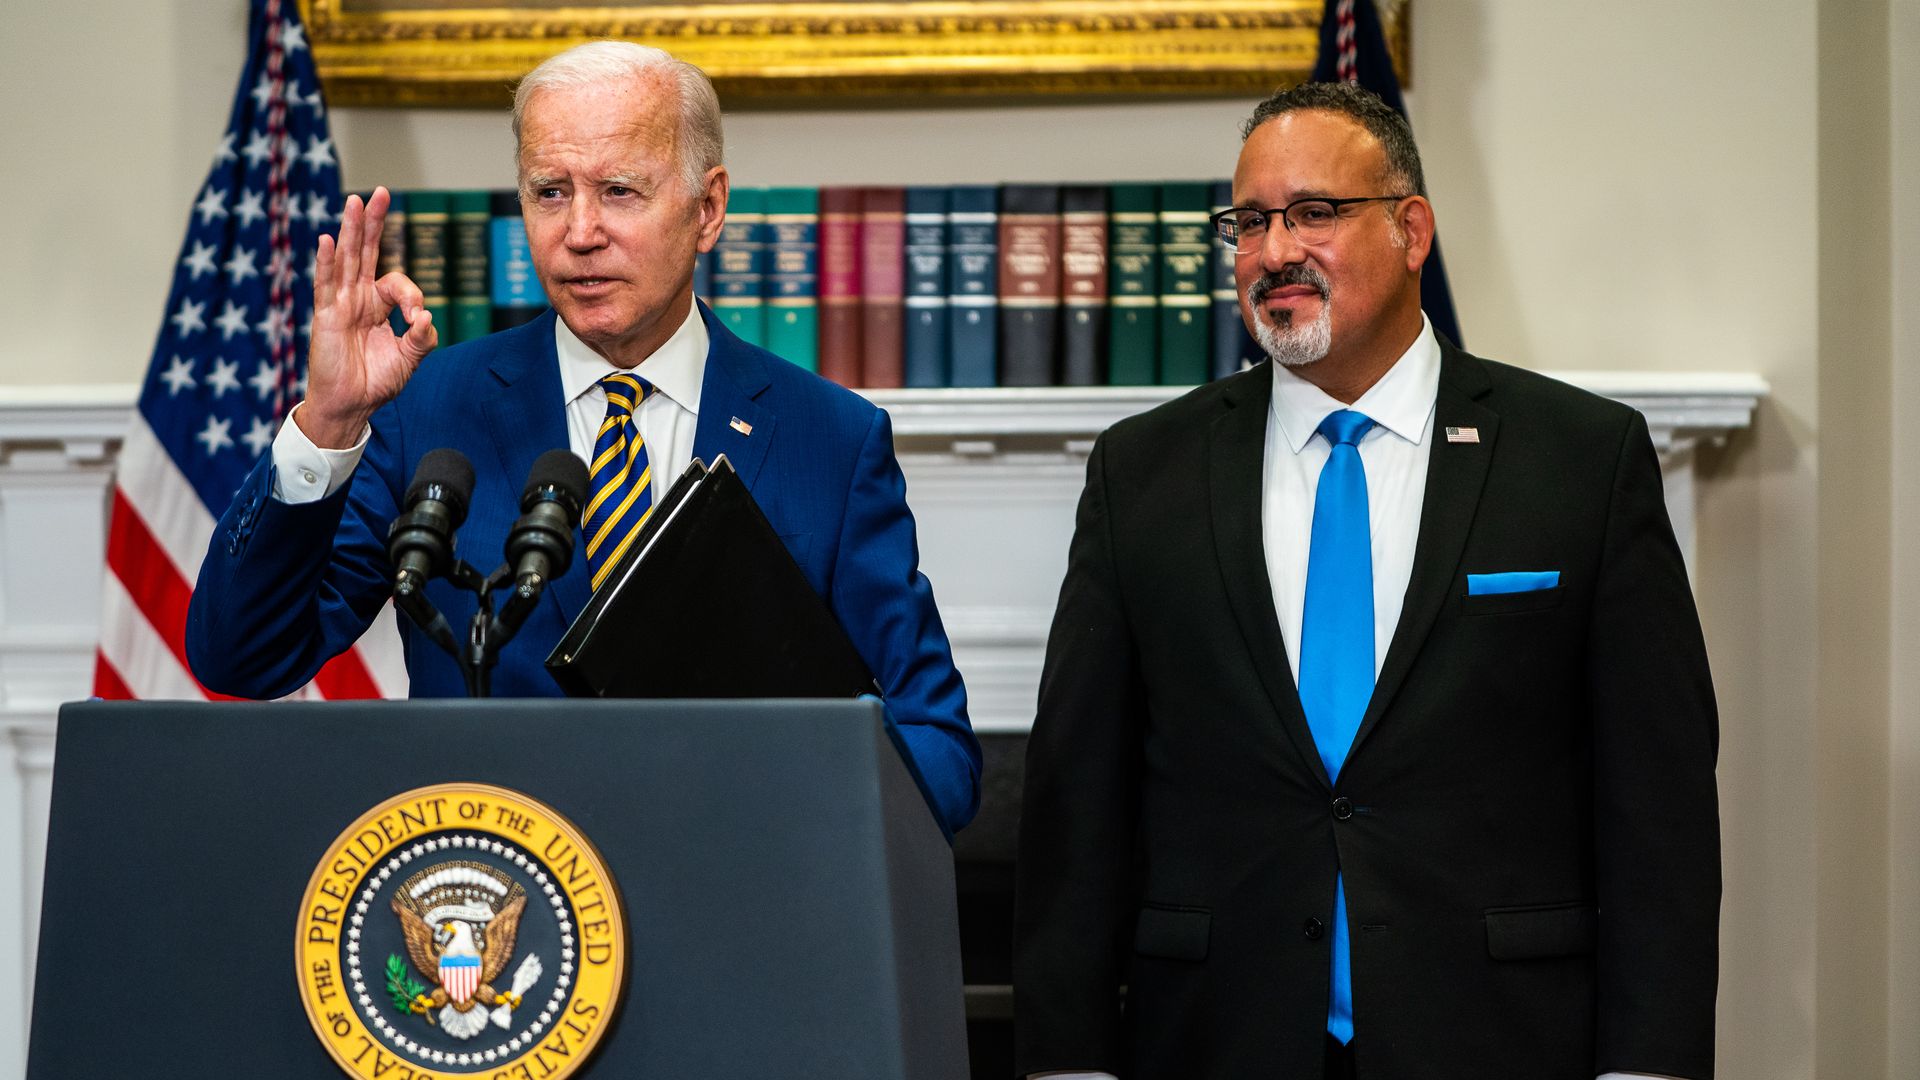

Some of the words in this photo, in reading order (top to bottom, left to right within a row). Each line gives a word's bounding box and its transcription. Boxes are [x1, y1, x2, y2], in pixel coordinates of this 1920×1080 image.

[458, 801, 488, 819] OF
[497, 806, 535, 837] THE
[308, 798, 446, 945] PRESIDENT
[544, 834, 611, 965] UNITED
[313, 958, 336, 1005] THE
[326, 1011, 351, 1037] OF
